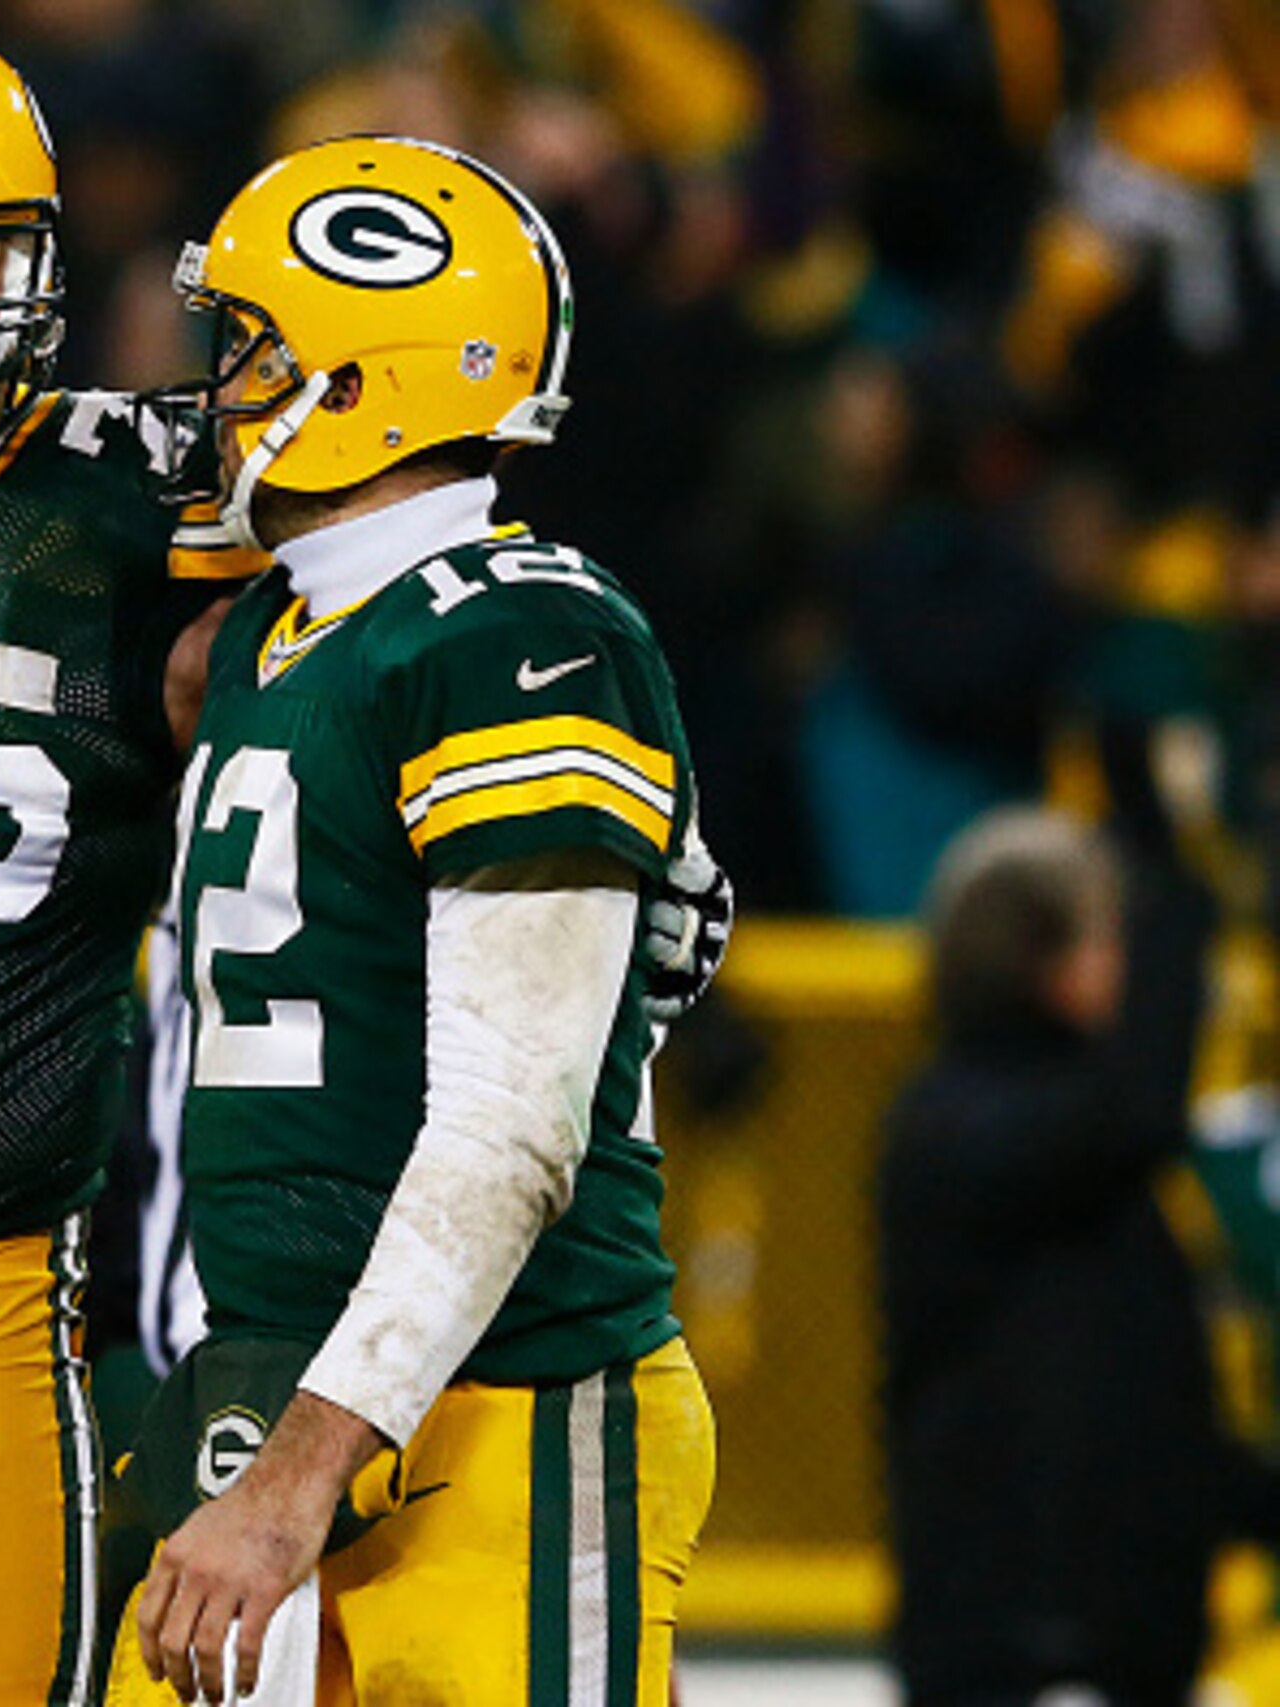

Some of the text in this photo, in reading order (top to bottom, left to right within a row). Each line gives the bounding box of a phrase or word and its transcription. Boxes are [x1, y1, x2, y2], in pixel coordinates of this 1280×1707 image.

[291, 188, 450, 286] G
[419, 546, 604, 618] 12
[173, 744, 324, 1088] 12
[196, 1407, 266, 1498] G
